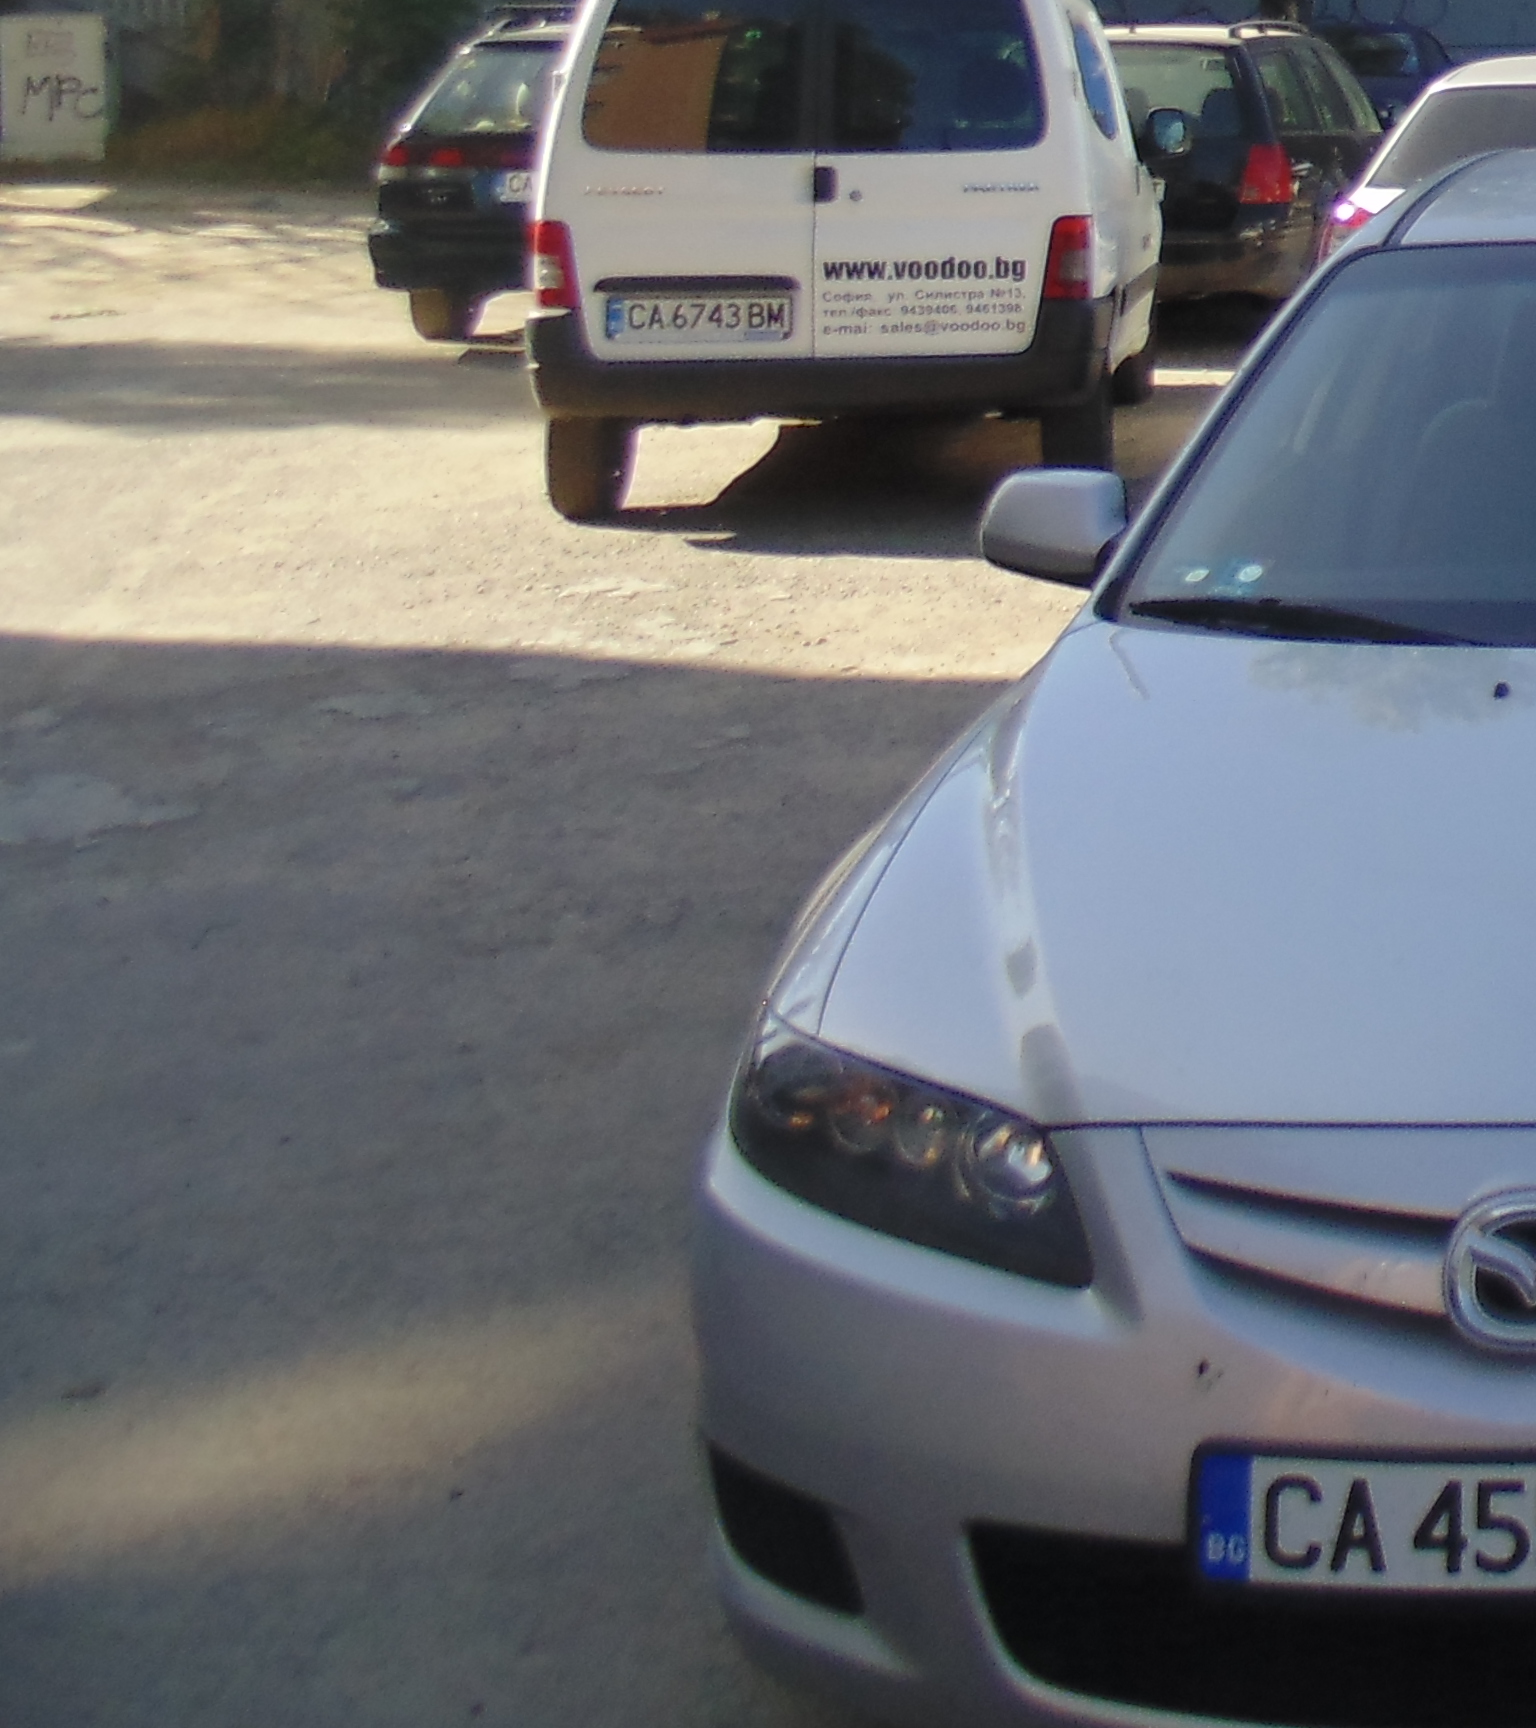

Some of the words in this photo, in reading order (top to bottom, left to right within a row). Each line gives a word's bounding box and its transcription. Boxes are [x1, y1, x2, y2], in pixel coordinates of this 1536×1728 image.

[822, 256, 1027, 282] www.voodoo.bg
[914, 289, 985, 301] Силистра
[628, 303, 664, 330] CA
[671, 303, 742, 329] 6743
[747, 302, 785, 328] BM
[1264, 1473, 1388, 1573] CA
